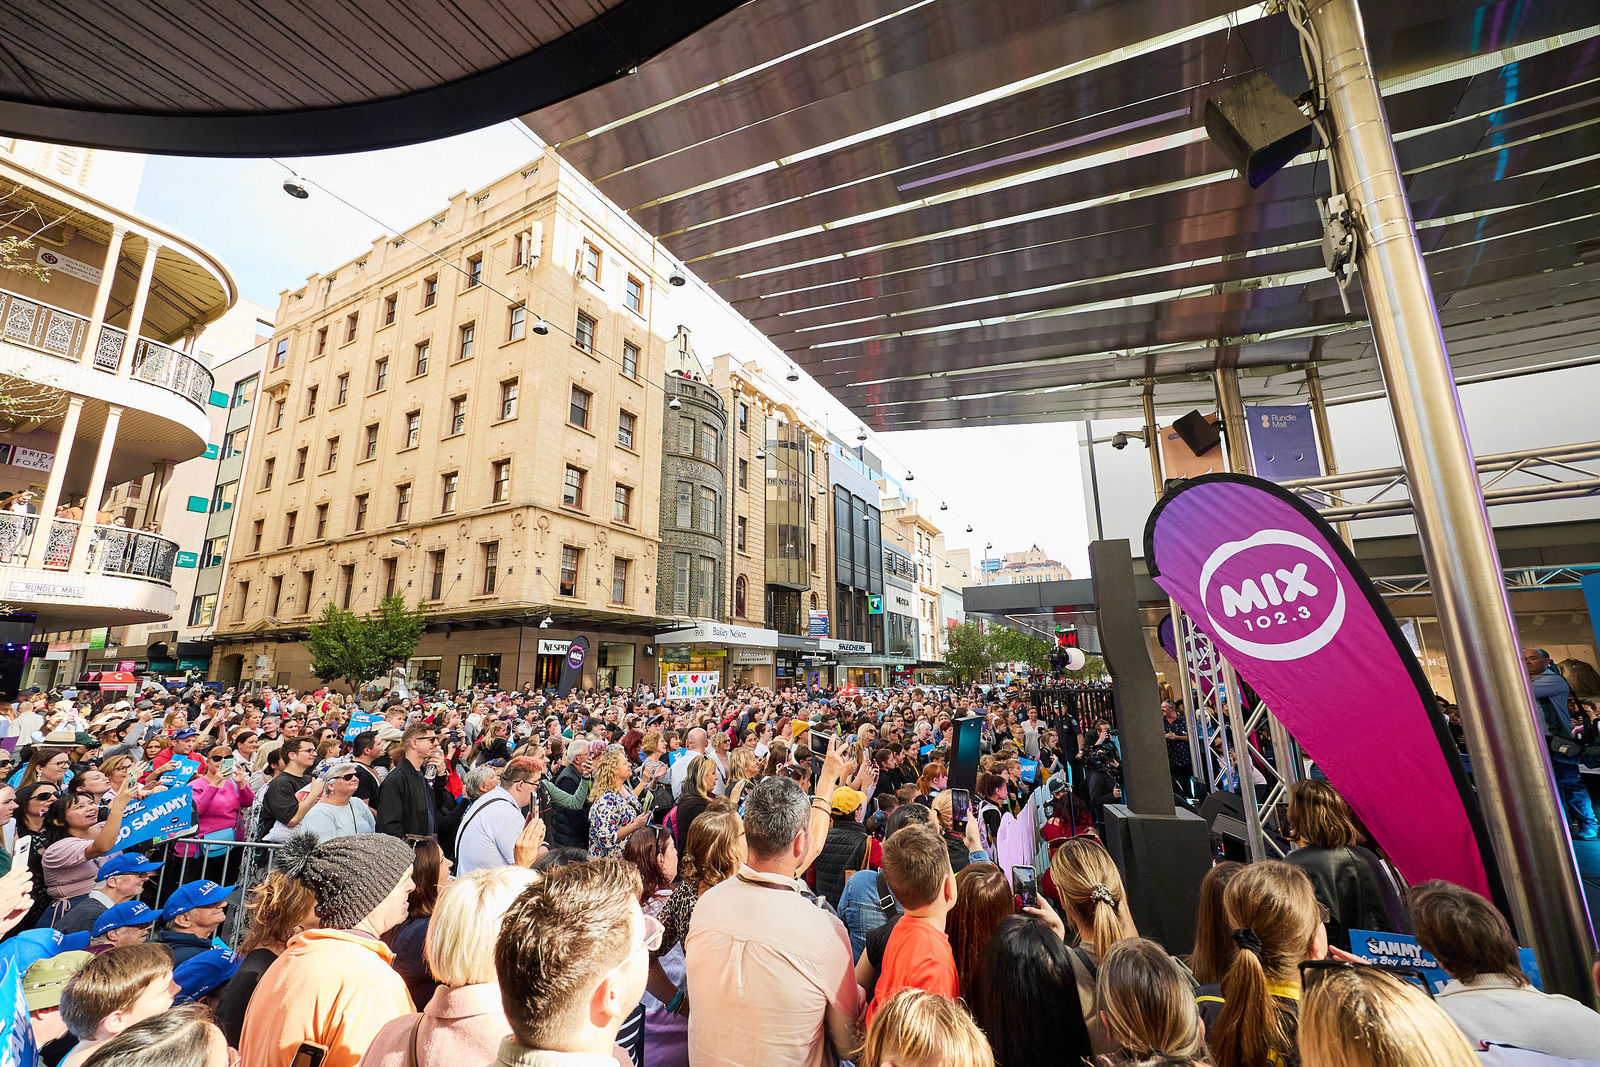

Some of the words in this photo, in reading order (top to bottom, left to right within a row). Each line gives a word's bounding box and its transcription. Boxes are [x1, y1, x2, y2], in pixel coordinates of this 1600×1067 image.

[21, 449, 55, 461] BRIDA
[16, 458, 49, 470] FORM
[767, 477, 797, 487] DENTIST
[25, 583, 57, 593] RUNDLE
[61, 587, 81, 595] MALL
[1220, 562, 1319, 618] MIX
[1243, 605, 1312, 632] 102.3
[712, 626, 729, 639] Bailey
[729, 629, 747, 639] Nelson
[543, 641, 571, 653] NESPR
[838, 642, 866, 652] SKECHERS
[570, 650, 583, 661] MIX
[678, 674, 688, 684] WE
[701, 675, 708, 684] U
[675, 686, 710, 697] SAMMY
[348, 726, 361, 736] GO
[131, 794, 189, 831] SAMMY
[1366, 938, 1422, 958] SAMMY
[1379, 956, 1399, 967] Boy
[1400, 957, 1411, 967] in
[1412, 958, 1438, 969] Blue
